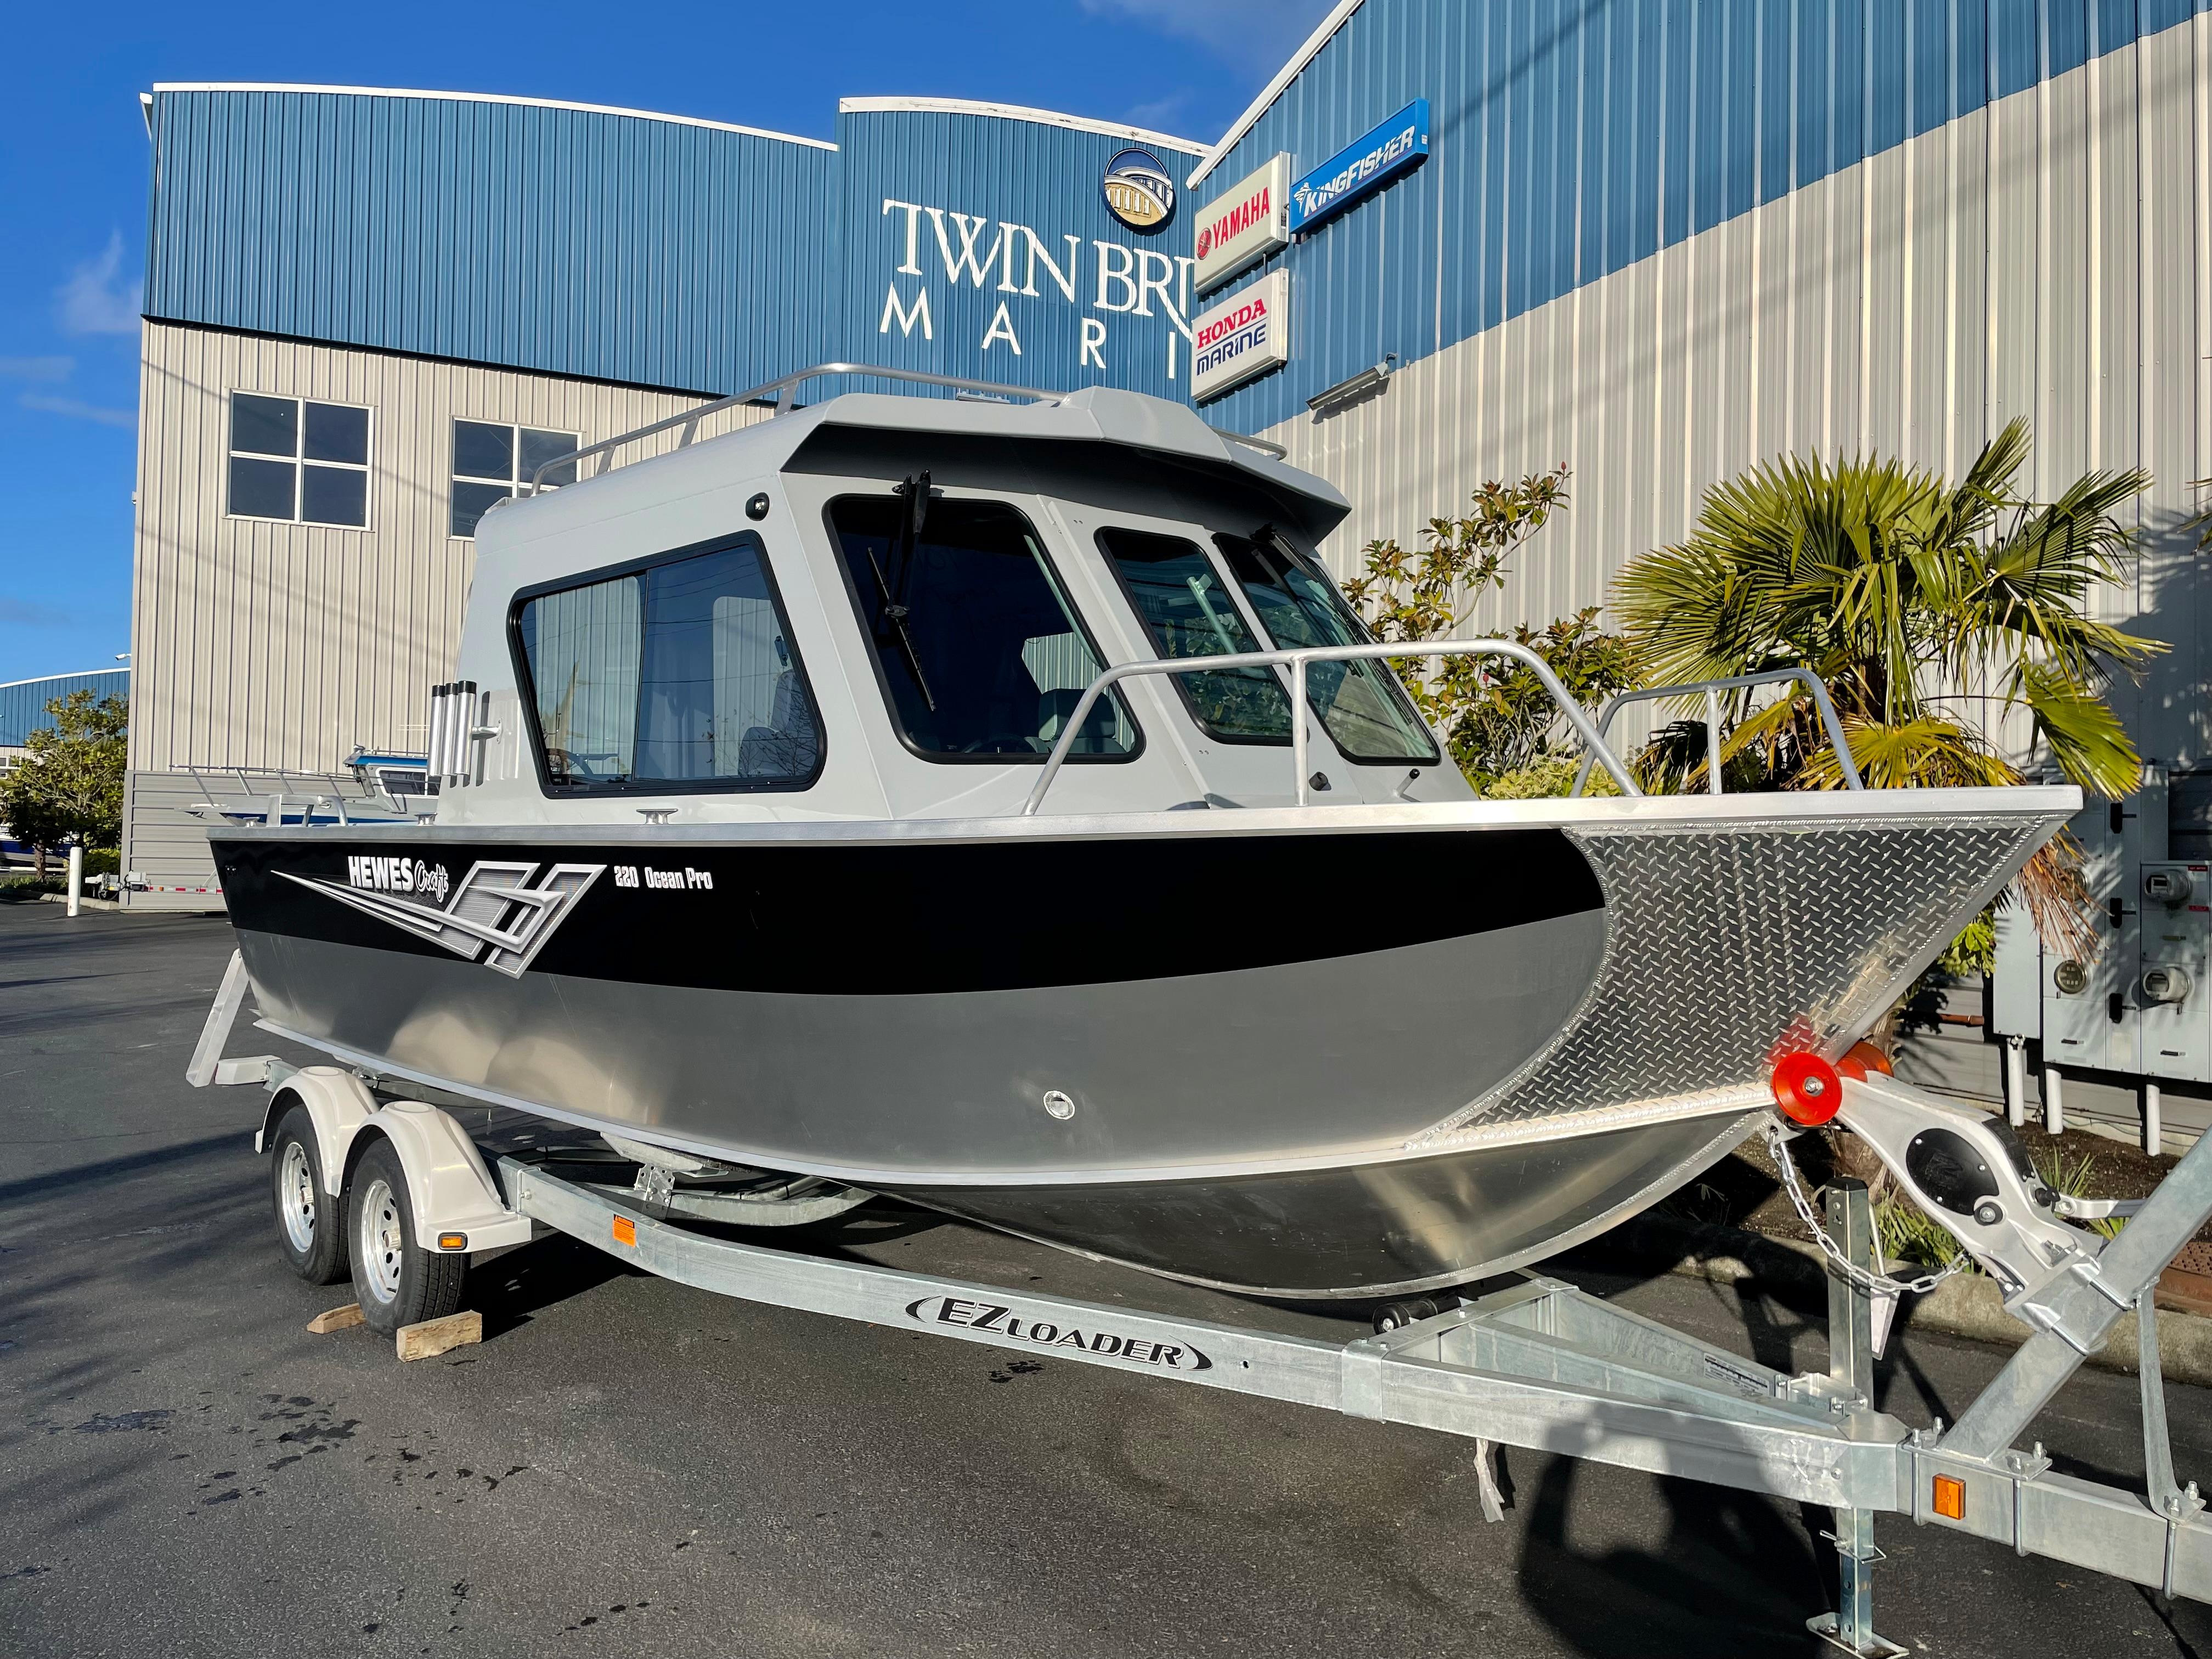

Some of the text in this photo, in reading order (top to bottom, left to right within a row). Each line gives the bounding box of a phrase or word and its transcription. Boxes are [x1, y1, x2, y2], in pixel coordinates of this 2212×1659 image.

[1304, 125, 1415, 217] KINGFISHER
[1212, 187, 1270, 250] YAMAHA
[883, 199, 1081, 303] TWIN
[1197, 323, 1266, 376] MARINE
[1198, 298, 1267, 349] HONDA
[348, 855, 449, 903] HEWES Craft
[613, 865, 713, 889] 220 Ocean Pro
